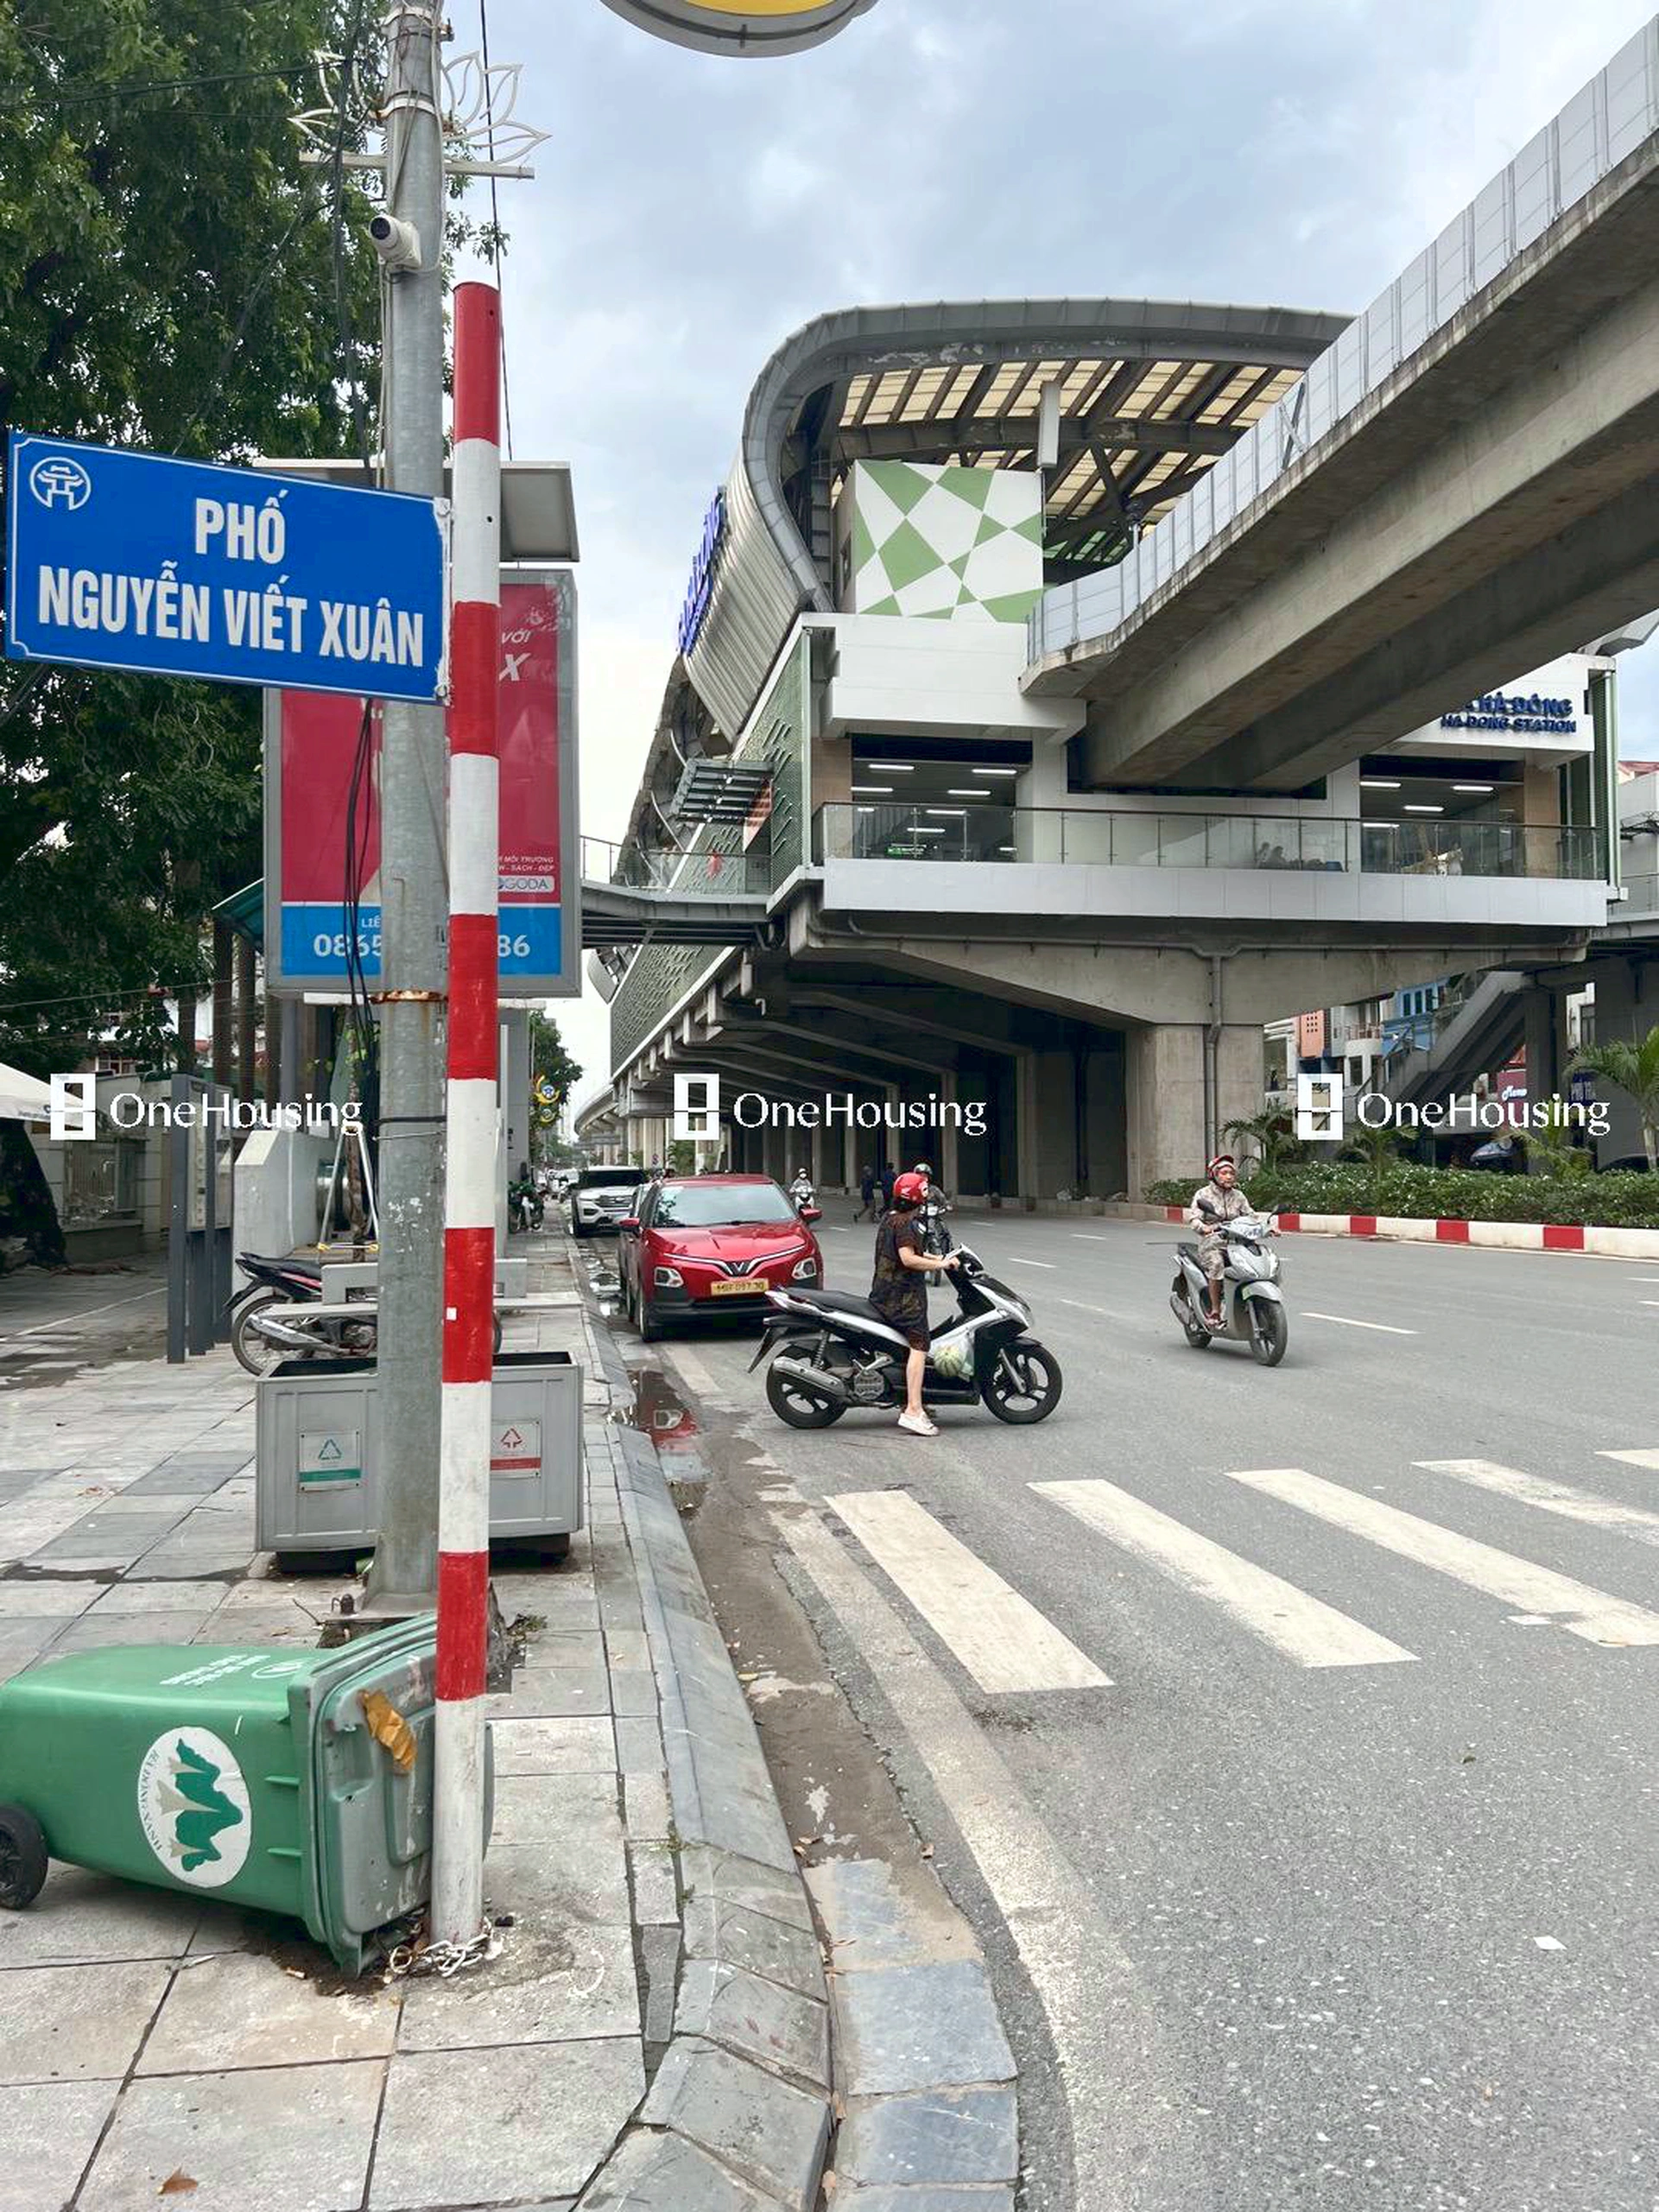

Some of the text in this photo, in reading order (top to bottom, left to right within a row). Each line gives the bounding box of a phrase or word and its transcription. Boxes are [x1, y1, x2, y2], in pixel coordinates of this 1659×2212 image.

[194, 488, 288, 565] PHỐ
[38, 561, 425, 667] NGUYỄN VIẾT XUÂN
